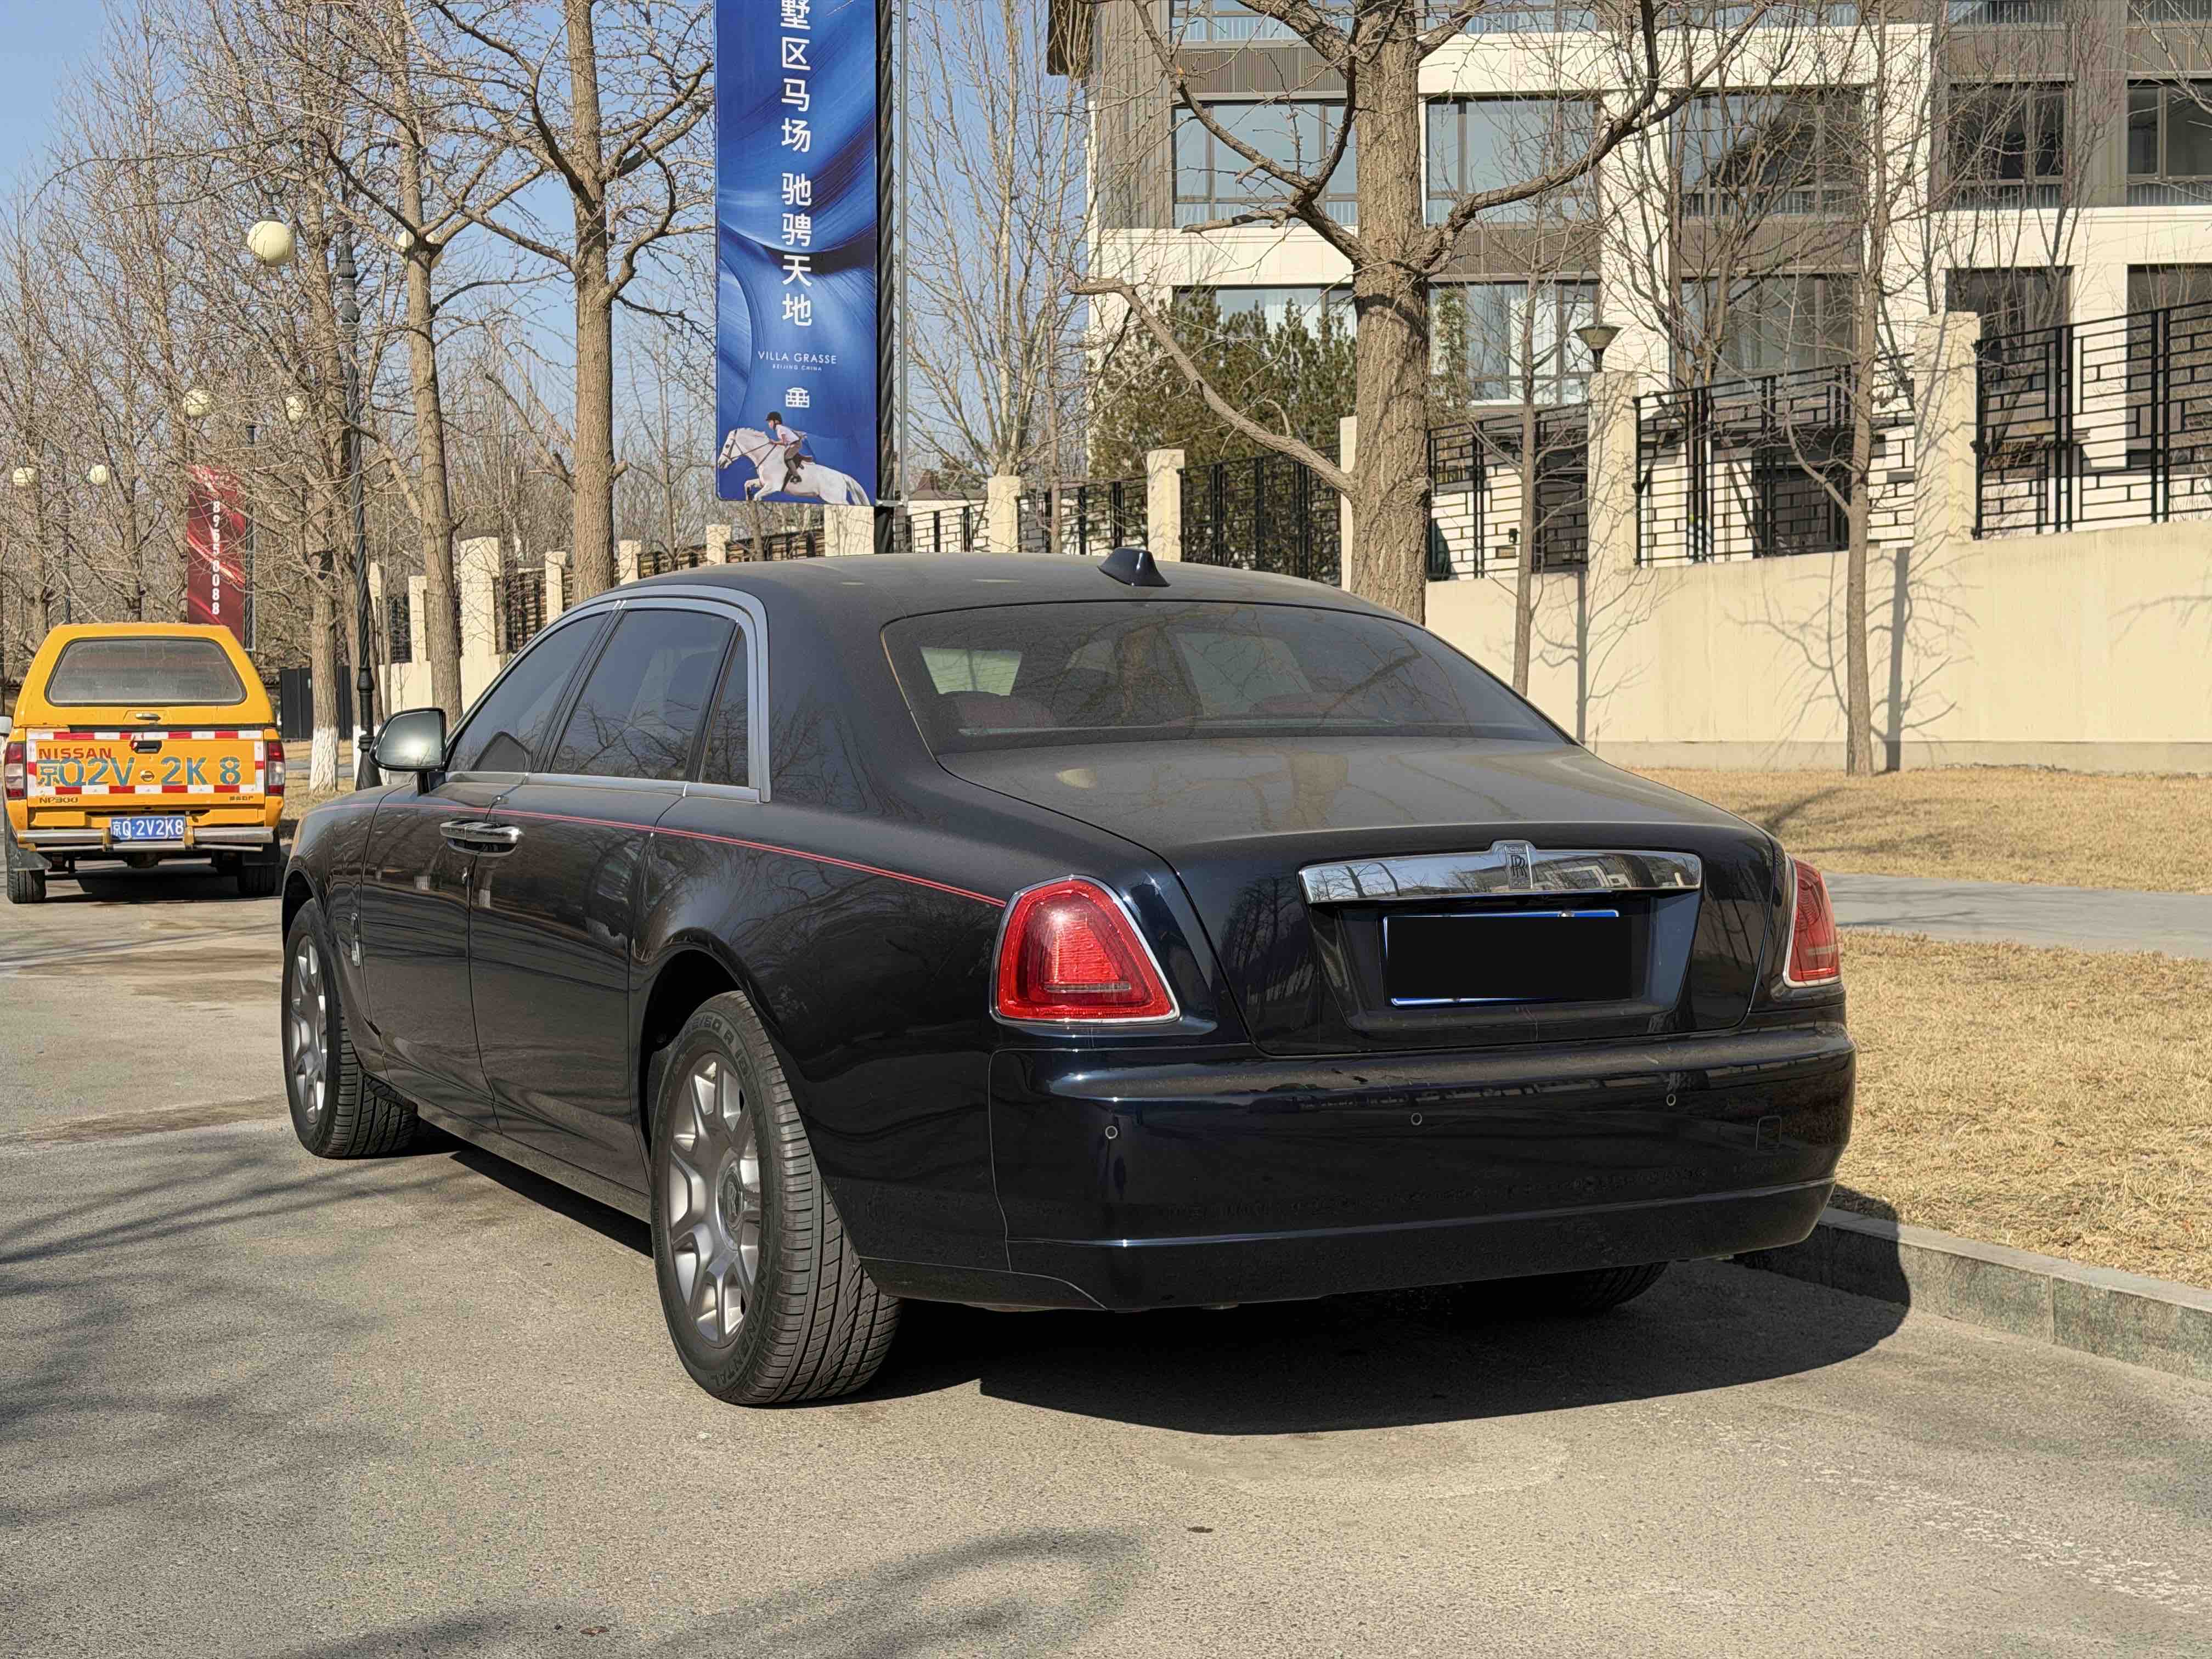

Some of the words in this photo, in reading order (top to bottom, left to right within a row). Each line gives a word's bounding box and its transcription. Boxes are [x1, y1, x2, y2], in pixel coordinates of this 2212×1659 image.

[781, 172, 812, 326] 驰骋天地
[758, 351, 789, 362] VILLA
[794, 353, 837, 364] GRASSE
[39, 747, 112, 759] NISSAN
